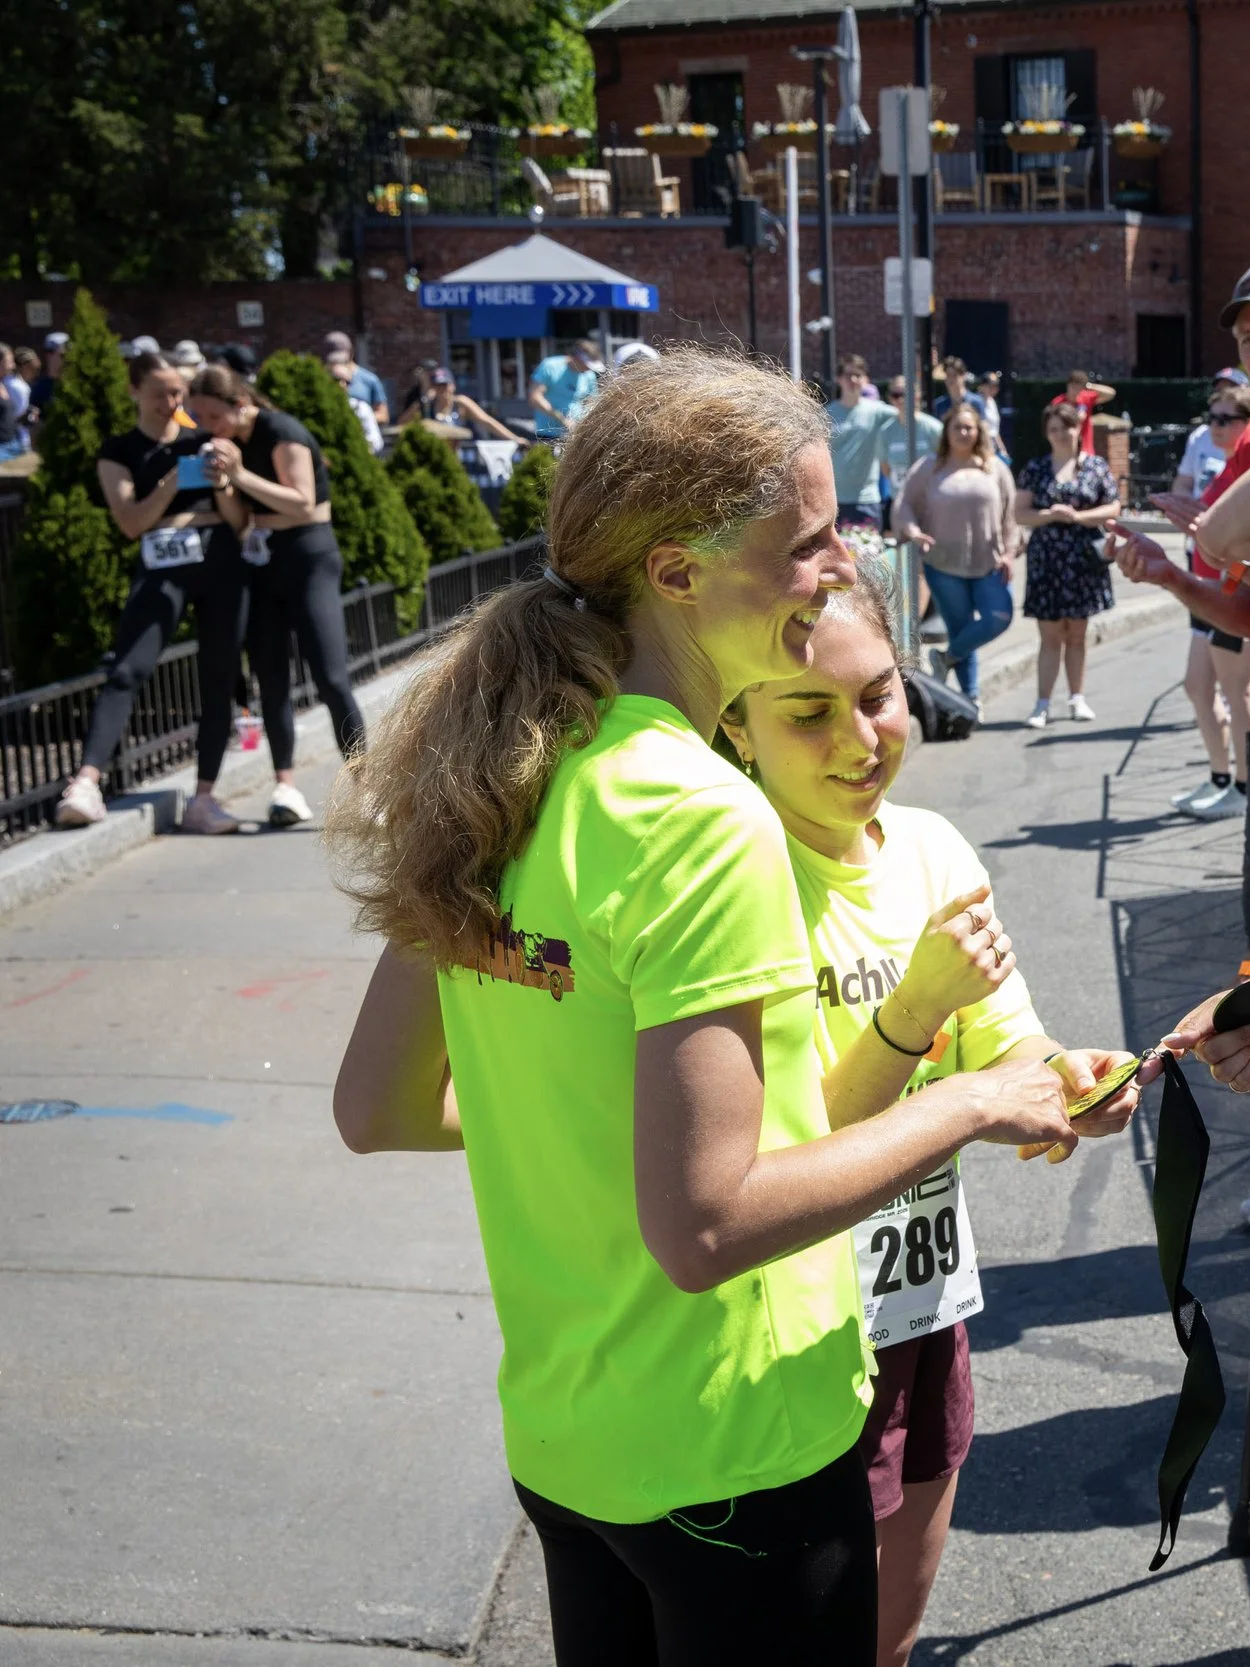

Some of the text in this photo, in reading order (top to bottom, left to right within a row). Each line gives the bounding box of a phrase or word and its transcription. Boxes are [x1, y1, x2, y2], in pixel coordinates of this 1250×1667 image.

[424, 285, 535, 305] EXIT HERE
[154, 540, 189, 560] 561
[870, 1206, 960, 1298] 289
[868, 1296, 977, 1343] OOD DRINK DRINK
